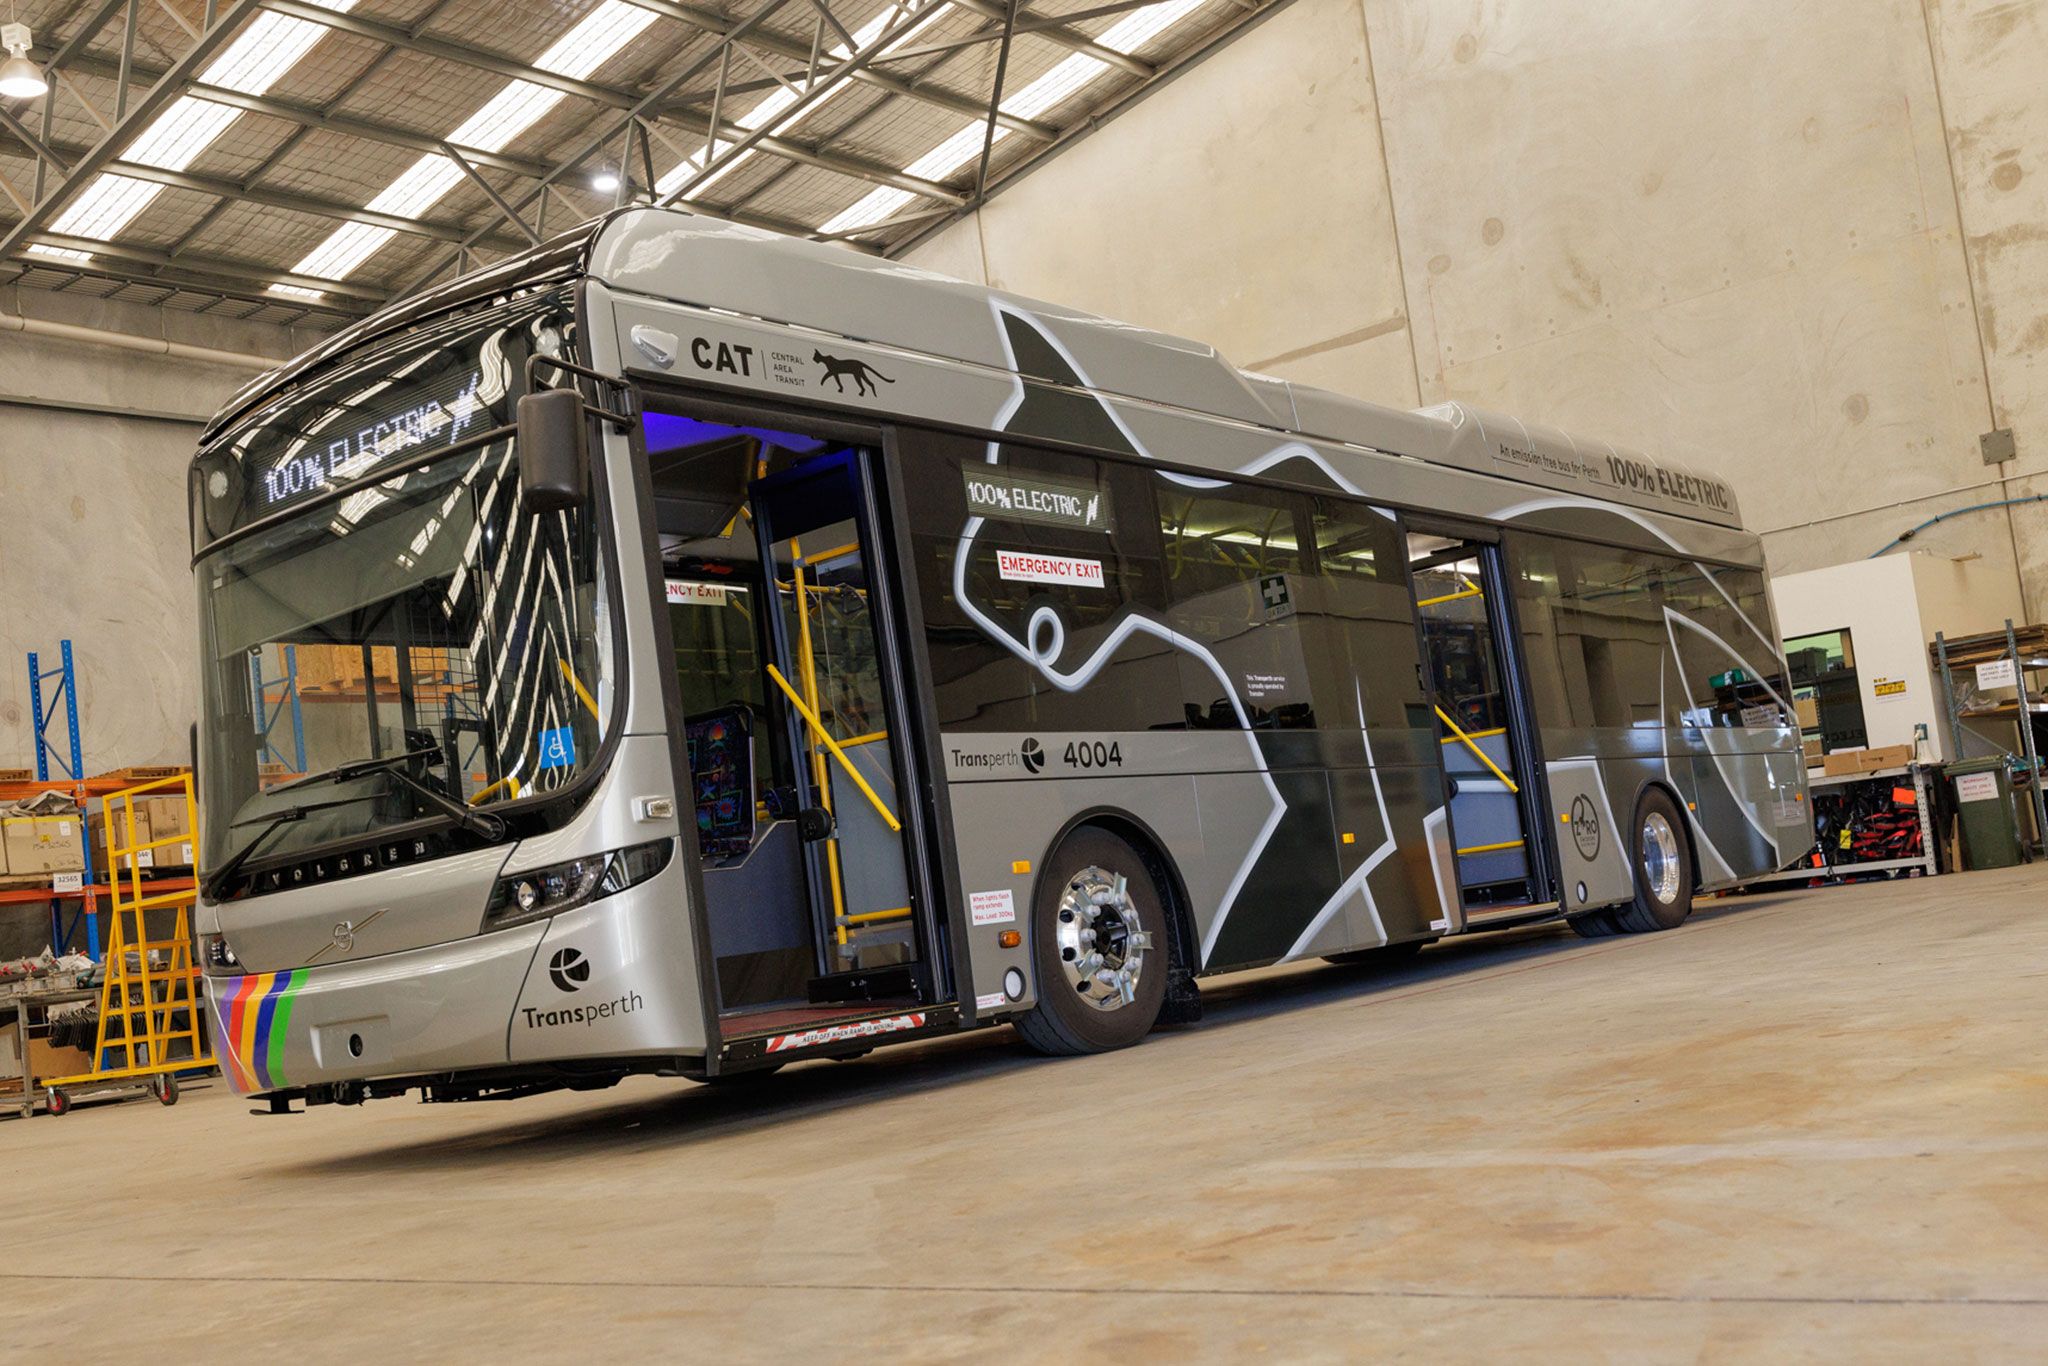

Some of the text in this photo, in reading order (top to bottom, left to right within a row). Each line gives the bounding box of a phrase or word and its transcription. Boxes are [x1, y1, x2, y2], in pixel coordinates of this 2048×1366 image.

[691, 337, 753, 376] CAT
[771, 352, 804, 365] CENTRAL
[774, 364, 793, 374] AREA
[775, 374, 805, 387] TRANSIT
[264, 453, 325, 502] 100%
[1511, 447, 1542, 466] emission
[1542, 453, 1557, 470] free
[1558, 457, 1571, 472] bus
[1571, 462, 1581, 475] for
[1582, 464, 1600, 479] Perth
[1606, 455, 1729, 510] 100% ELECTRIC
[968, 481, 1082, 517] 100% ELECTRIC
[1000, 555, 1100, 579] EMERGENCY EXIT
[697, 585, 724, 598] EXIT
[951, 748, 1018, 771] Transperth
[1063, 741, 1122, 768] 4004
[272, 842, 425, 886] VOLGREN
[522, 990, 643, 1029] Transperth
